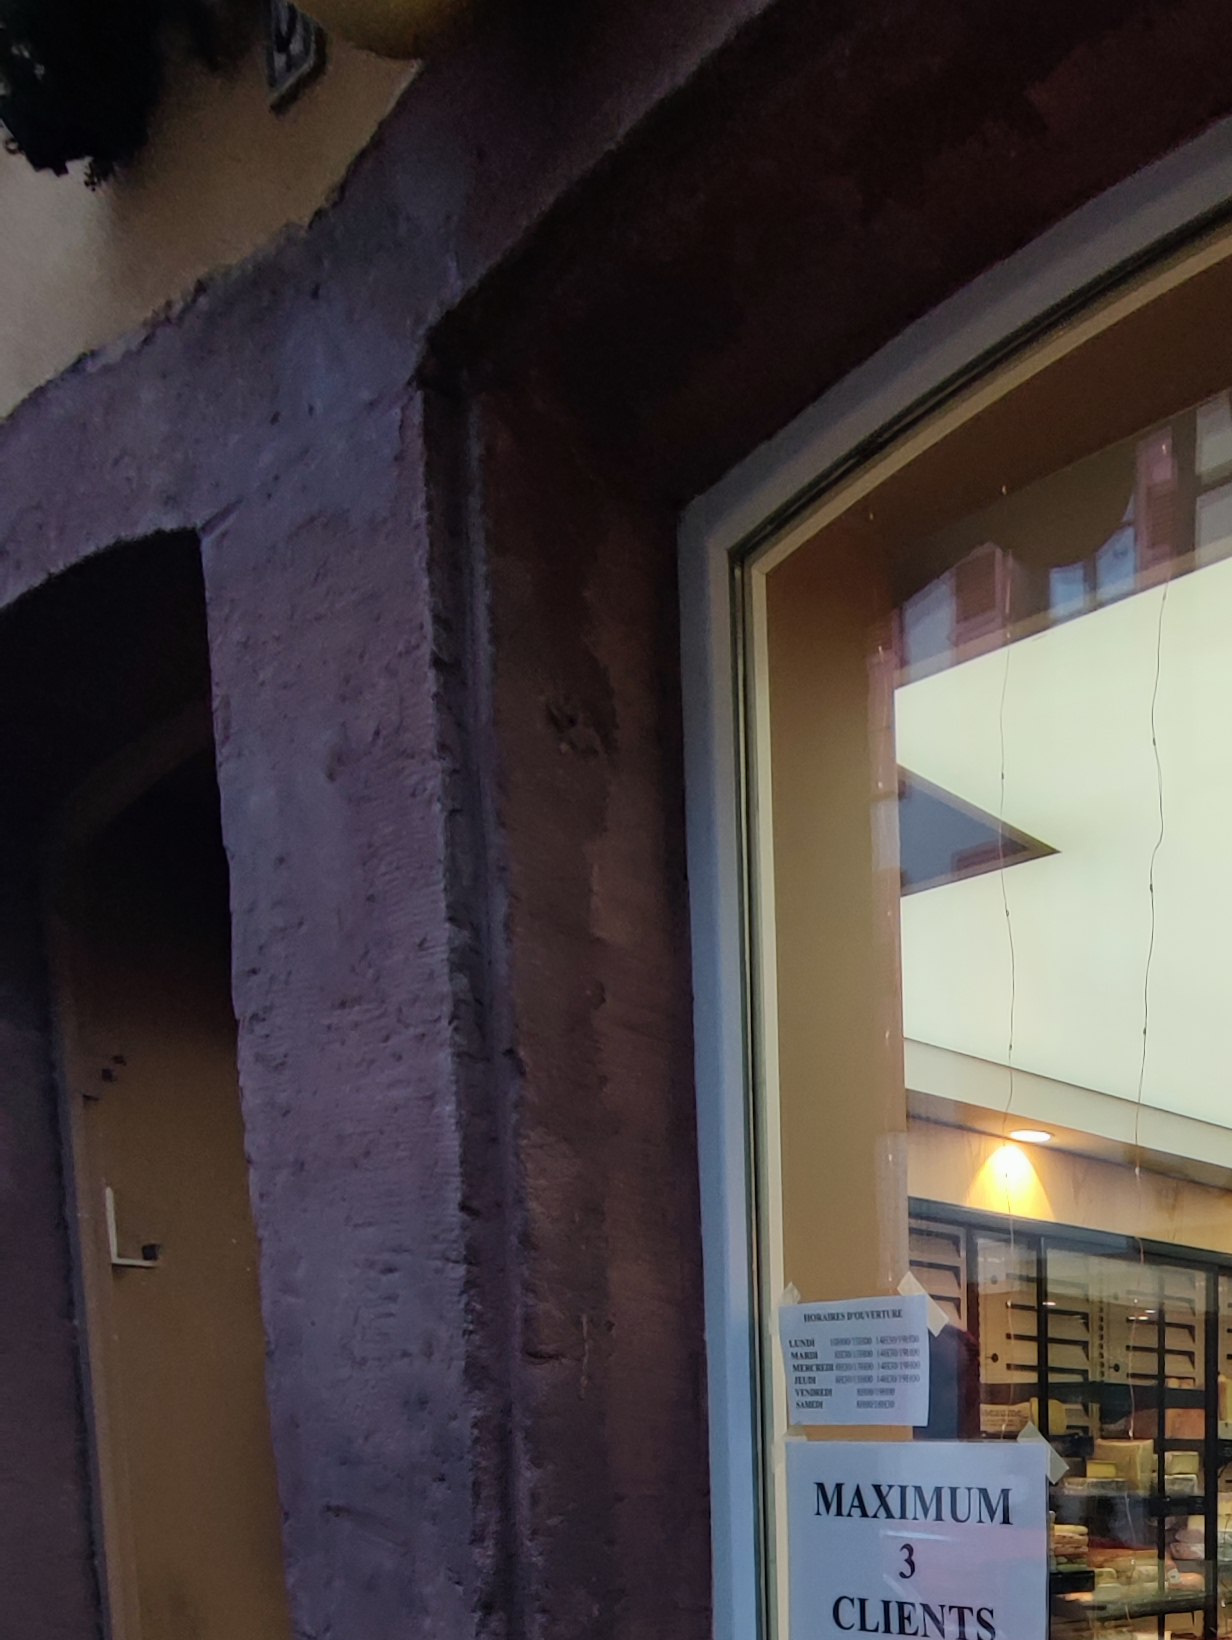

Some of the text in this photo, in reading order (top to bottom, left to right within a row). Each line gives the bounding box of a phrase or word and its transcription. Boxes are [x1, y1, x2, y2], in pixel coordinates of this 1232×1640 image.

[804, 1309, 903, 1323] HORAIRES D'OUVERTURE
[788, 1338, 815, 1348] LUNDI
[790, 1351, 818, 1360] MARDI
[792, 1363, 834, 1372] MERCREDI
[794, 1376, 816, 1385] JEUDI
[795, 1388, 832, 1397] VENDREDI
[796, 1400, 823, 1409] SAMEDI
[813, 1481, 1014, 1525] MAXIMUM
[898, 1542, 916, 1579] 3
